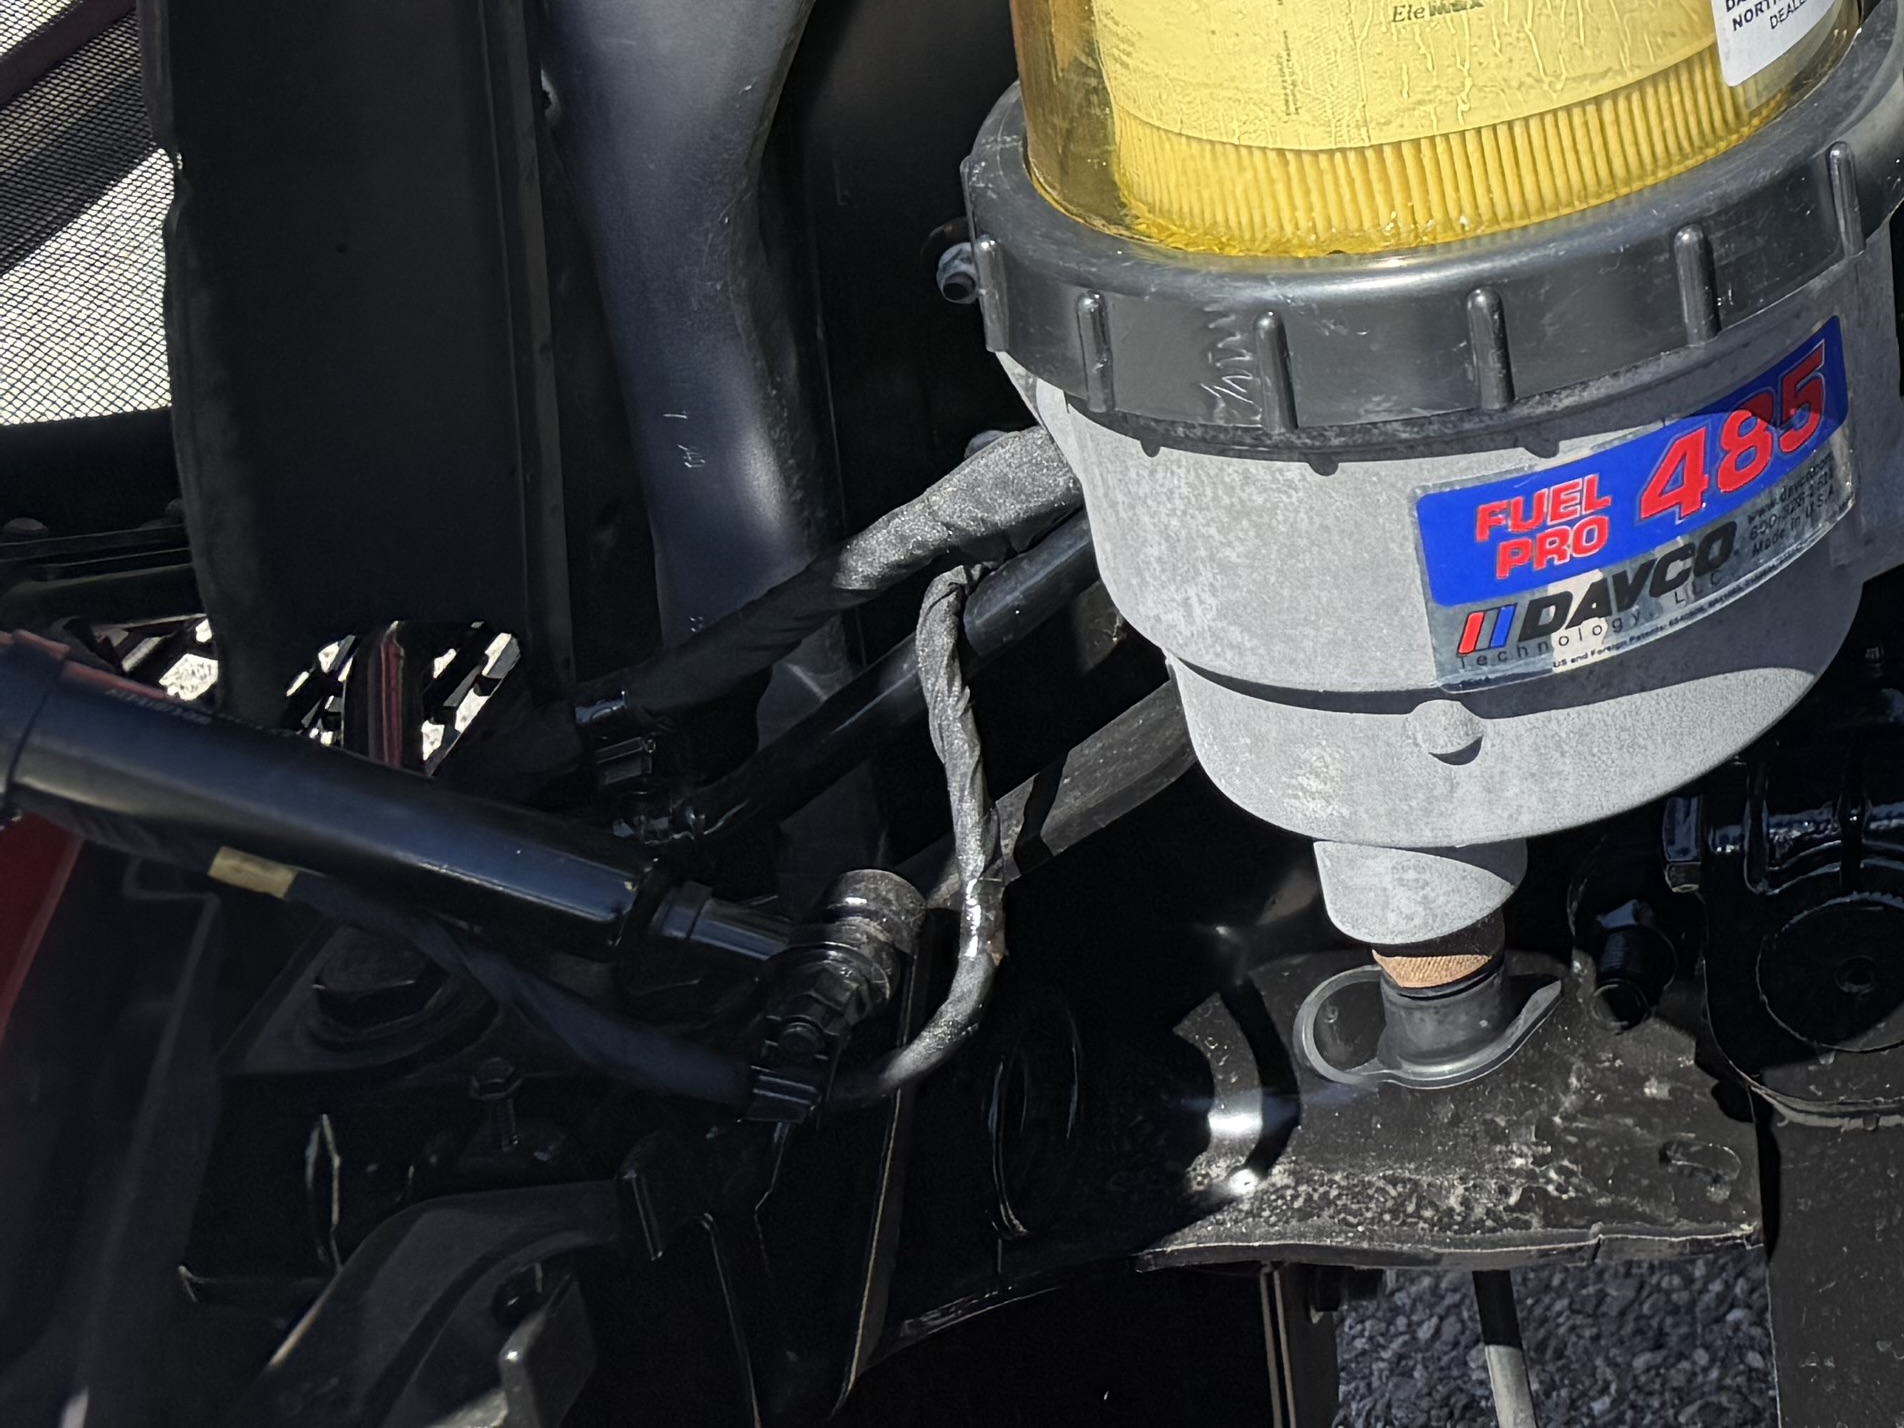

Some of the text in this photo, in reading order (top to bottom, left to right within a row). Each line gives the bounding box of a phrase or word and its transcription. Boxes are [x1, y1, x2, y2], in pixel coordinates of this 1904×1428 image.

[1637, 339, 1827, 525] 485
[1475, 473, 1612, 543] FUEL
[1496, 515, 1611, 580] PRO
[1518, 522, 1738, 641] DAVCO
